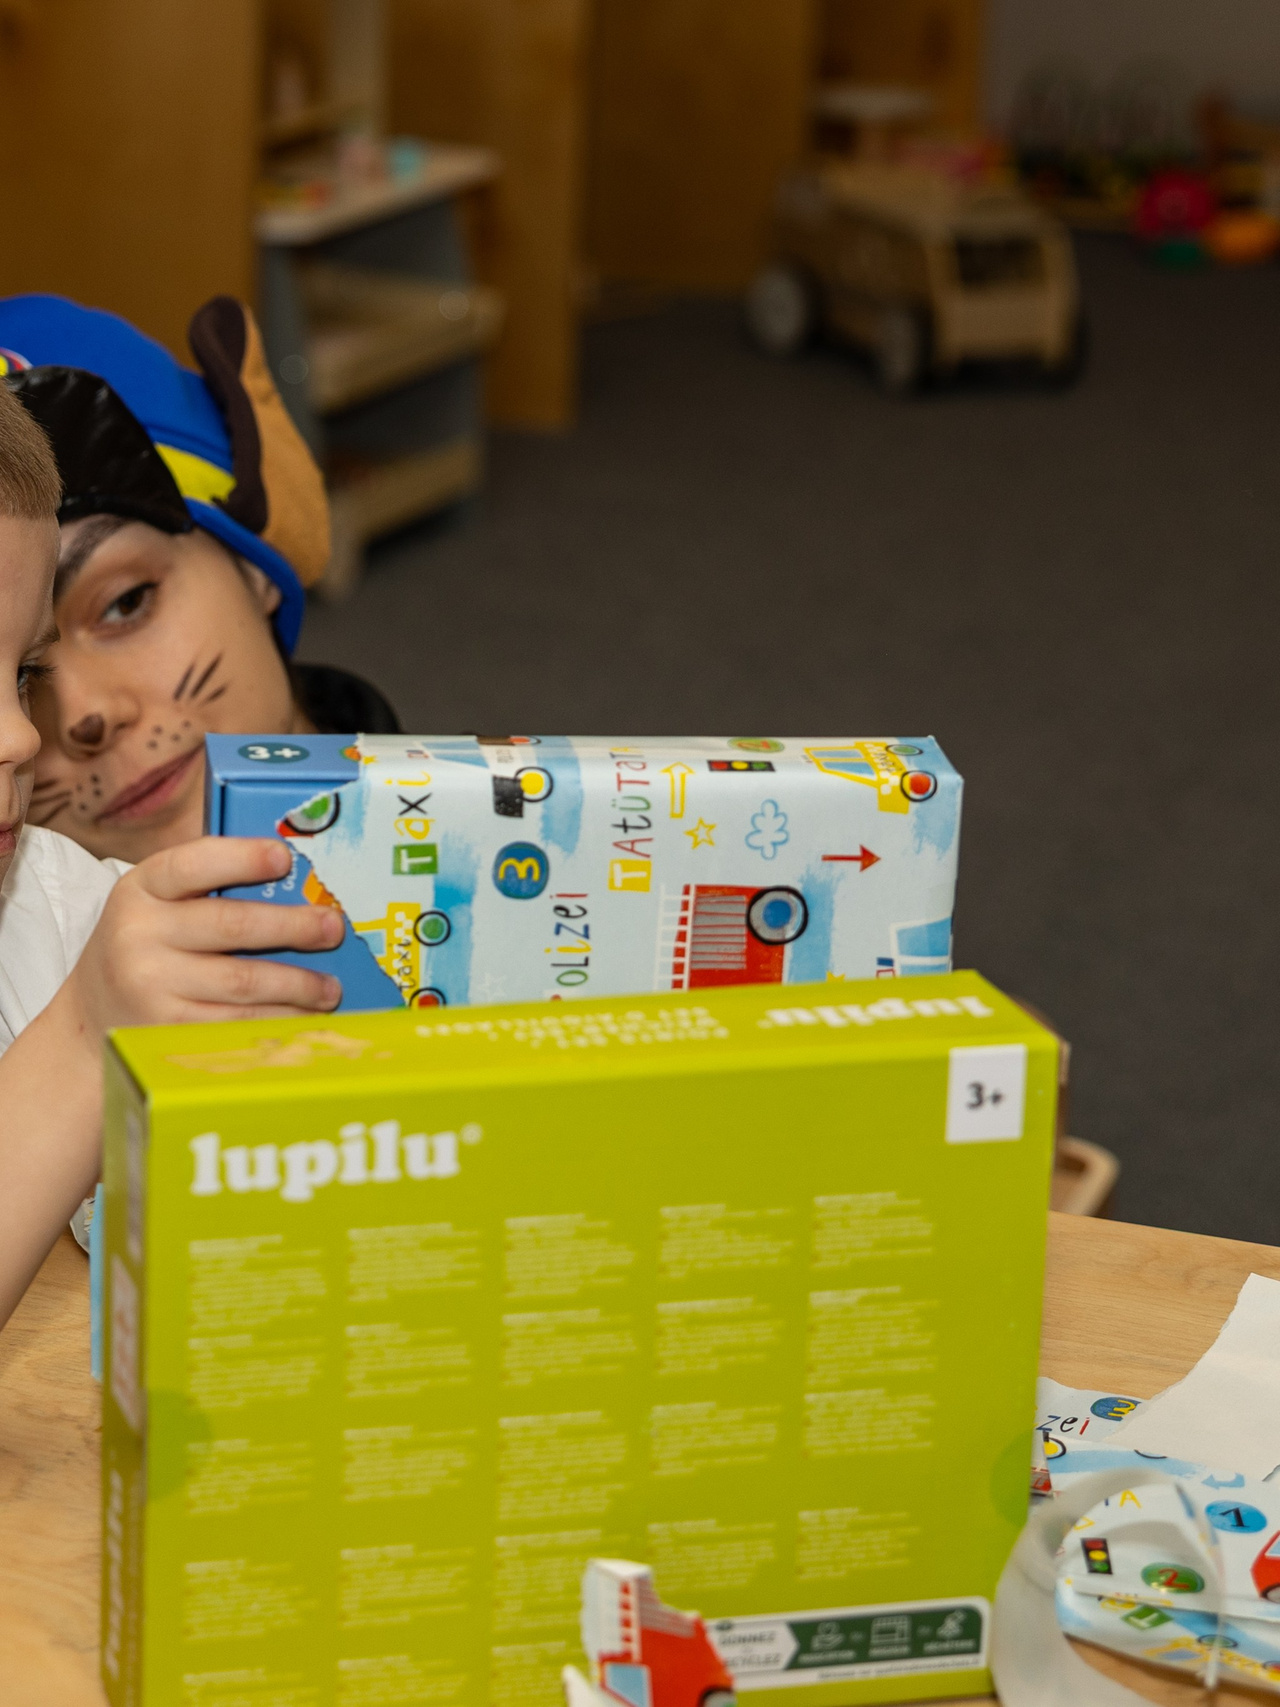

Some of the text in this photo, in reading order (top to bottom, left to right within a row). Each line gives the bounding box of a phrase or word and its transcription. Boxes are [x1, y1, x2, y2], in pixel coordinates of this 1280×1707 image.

[247, 745, 301, 760] 3+
[384, 770, 437, 874] Taxi
[498, 857, 541, 882] 3
[966, 1081, 1004, 1111] 3+
[189, 1118, 461, 1204] lupilu
[1107, 1399, 1137, 1417] 3
[1036, 1414, 1090, 1436] zei
[1219, 1506, 1251, 1528] 1
[1158, 1567, 1191, 1590] 2
